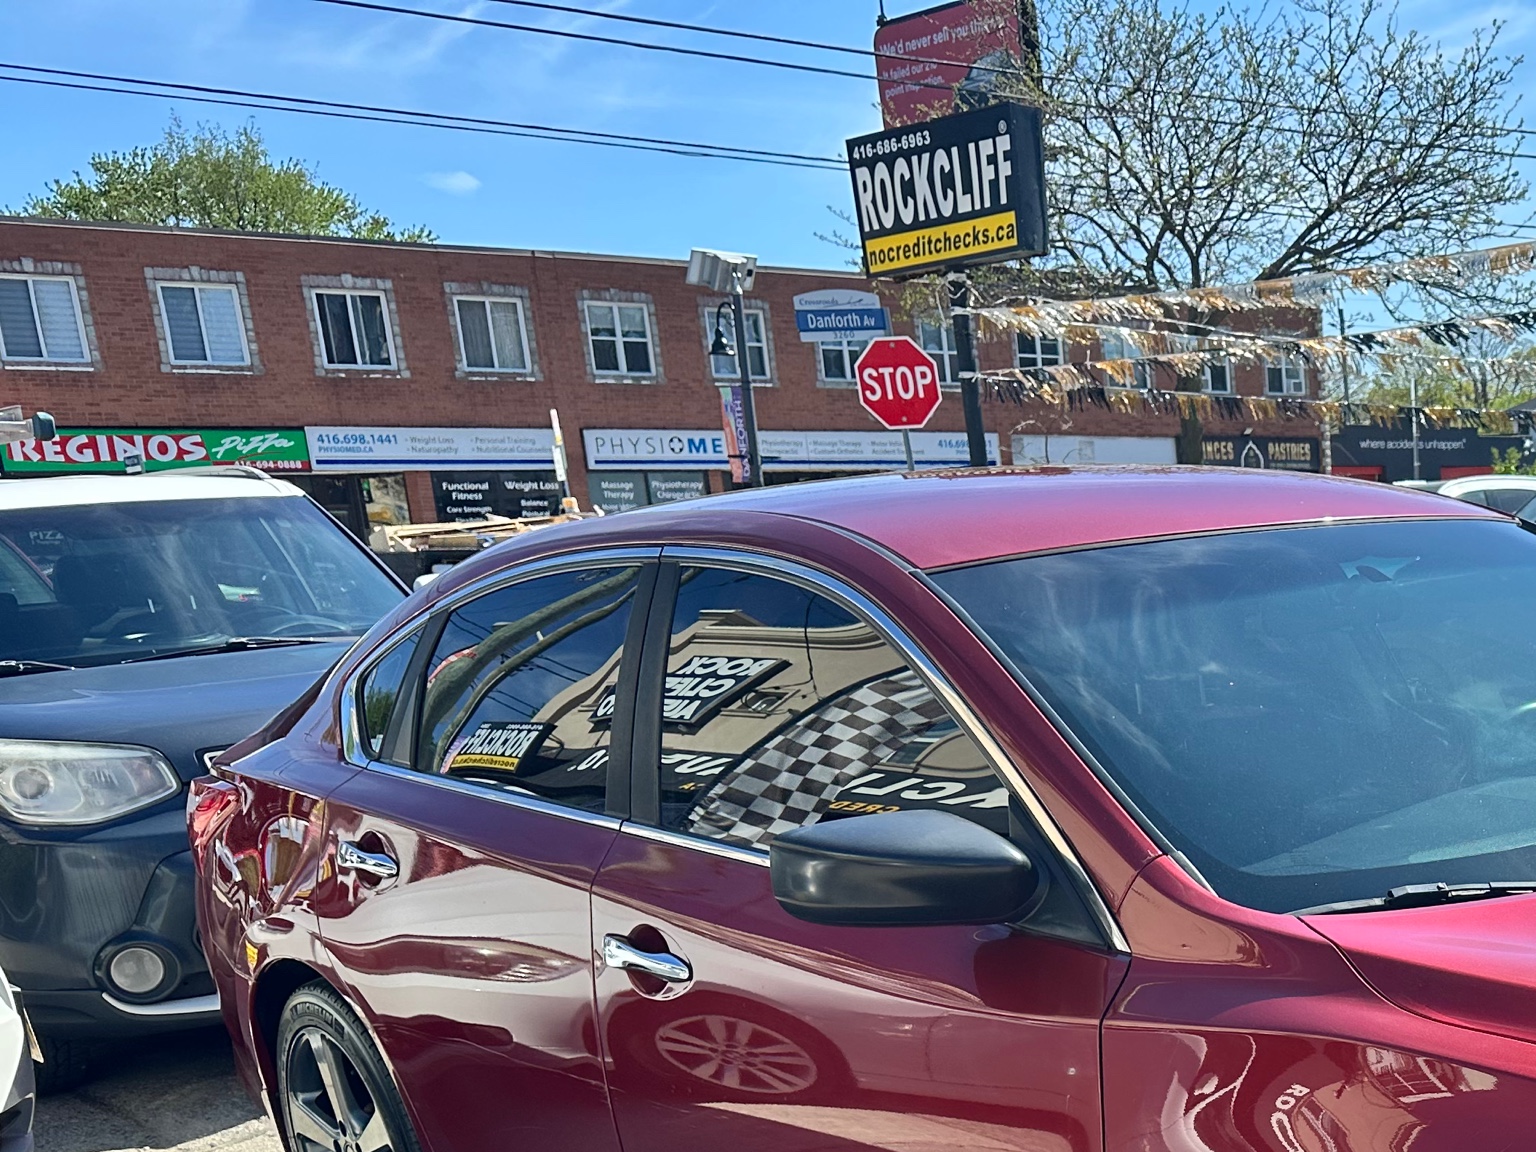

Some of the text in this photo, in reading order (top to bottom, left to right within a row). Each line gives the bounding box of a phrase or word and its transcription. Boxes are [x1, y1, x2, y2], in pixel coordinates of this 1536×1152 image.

[905, 35, 931, 52] never
[933, 26, 949, 45] sell
[889, 65, 910, 78] failed
[911, 65, 925, 75] our
[852, 130, 931, 160] 416-686-6963
[855, 134, 1012, 232] ROCKCLIFF
[869, 222, 1015, 266] nocreditchecks.ca
[807, 312, 875, 328] Danforth Av
[862, 365, 933, 401] STOP
[9, 434, 208, 462] REGINOS
[212, 433, 294, 459] Pizza
[317, 433, 398, 446] 416.698.1441
[1359, 440, 1385, 449] where
[1387, 440, 1423, 449] accidens
[1268, 443, 1311, 460] PASTRIES
[442, 482, 489, 491] Functional
[452, 492, 483, 500] Fitness
[504, 481, 559, 492] Weight Loss
[297, 1001, 334, 1025] MICHELIN
